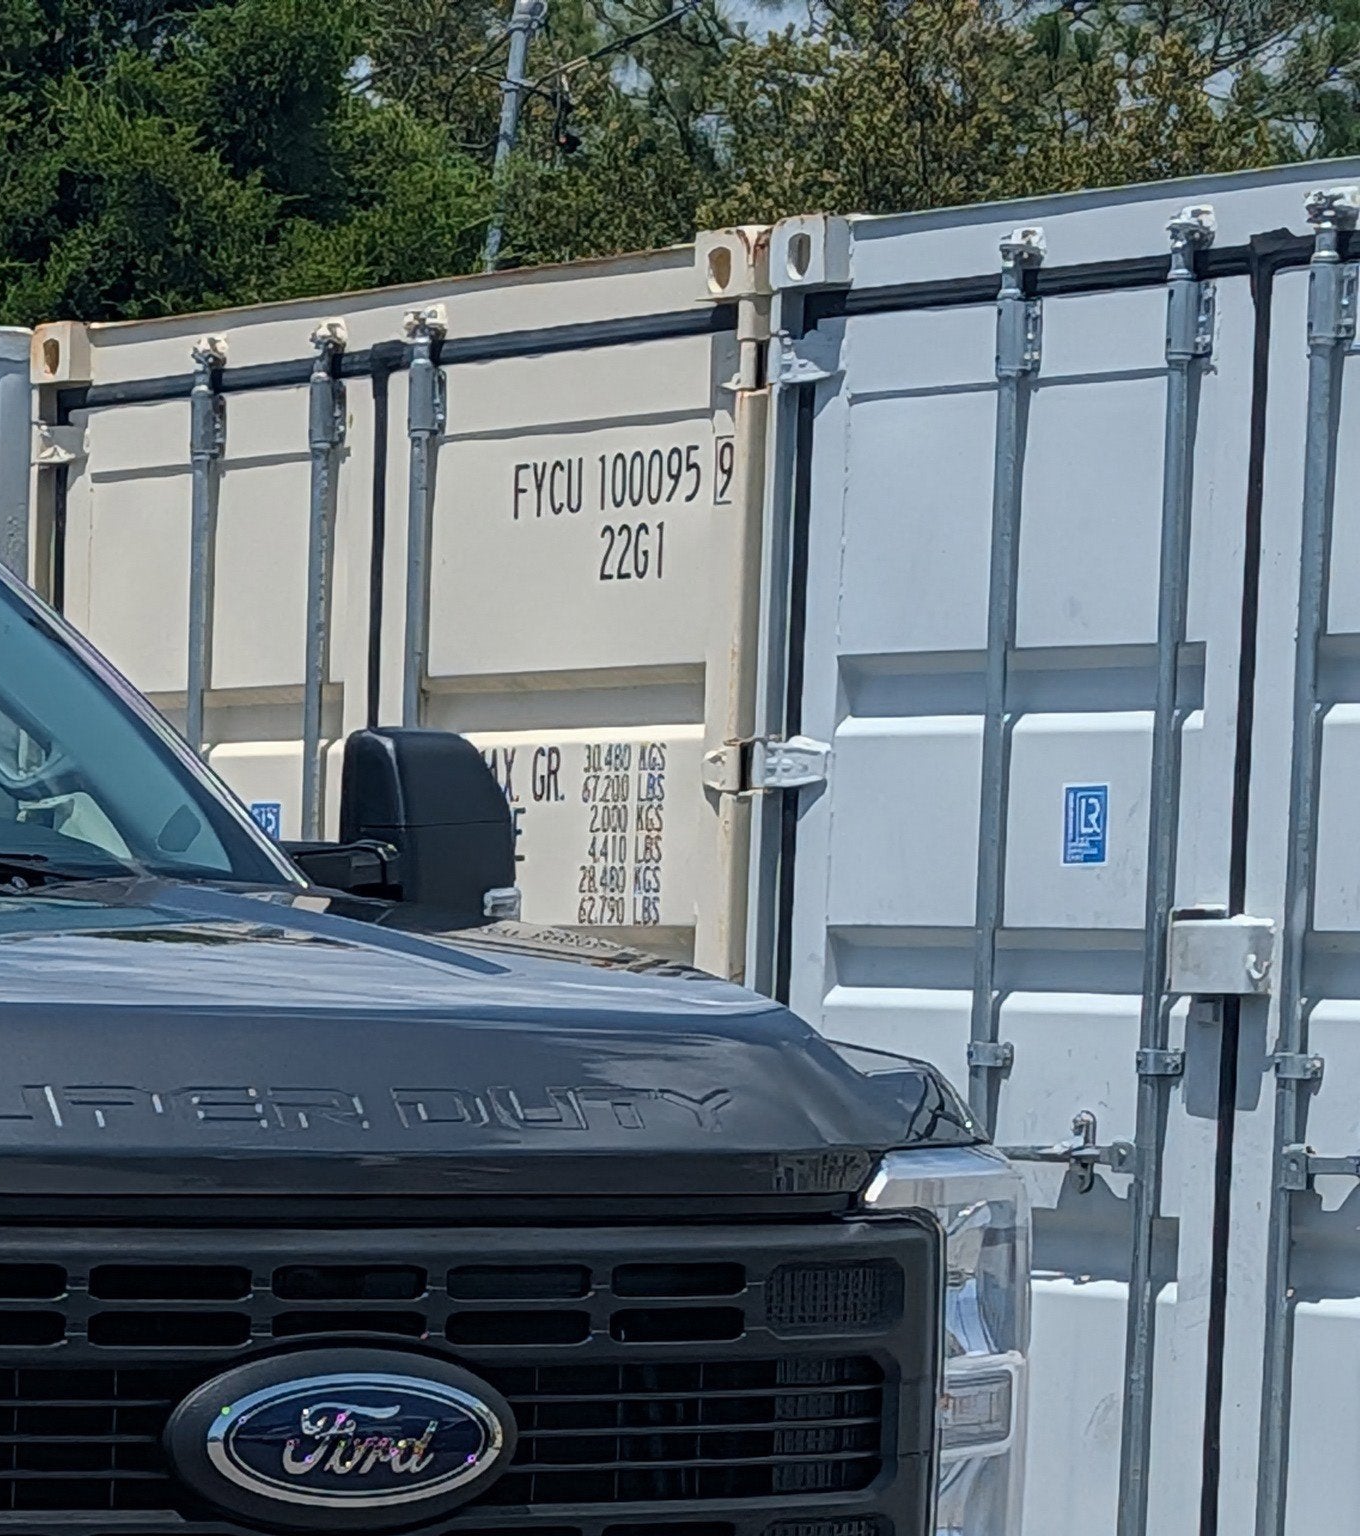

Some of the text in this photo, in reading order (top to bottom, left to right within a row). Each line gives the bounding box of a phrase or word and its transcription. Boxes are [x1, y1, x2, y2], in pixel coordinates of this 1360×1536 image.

[513, 441, 735, 520] FYCU 100095 9
[599, 520, 665, 581] 22G1
[638, 742, 667, 772] KGS
[532, 746, 565, 802] GR.
[636, 773, 665, 802] LBS
[636, 803, 664, 833] KGS
[635, 834, 662, 863] LBS
[633, 865, 661, 894] KGS
[633, 896, 660, 924] LBS
[389, 1084, 731, 1132] DUTY
[282, 1401, 437, 1475] Ford
